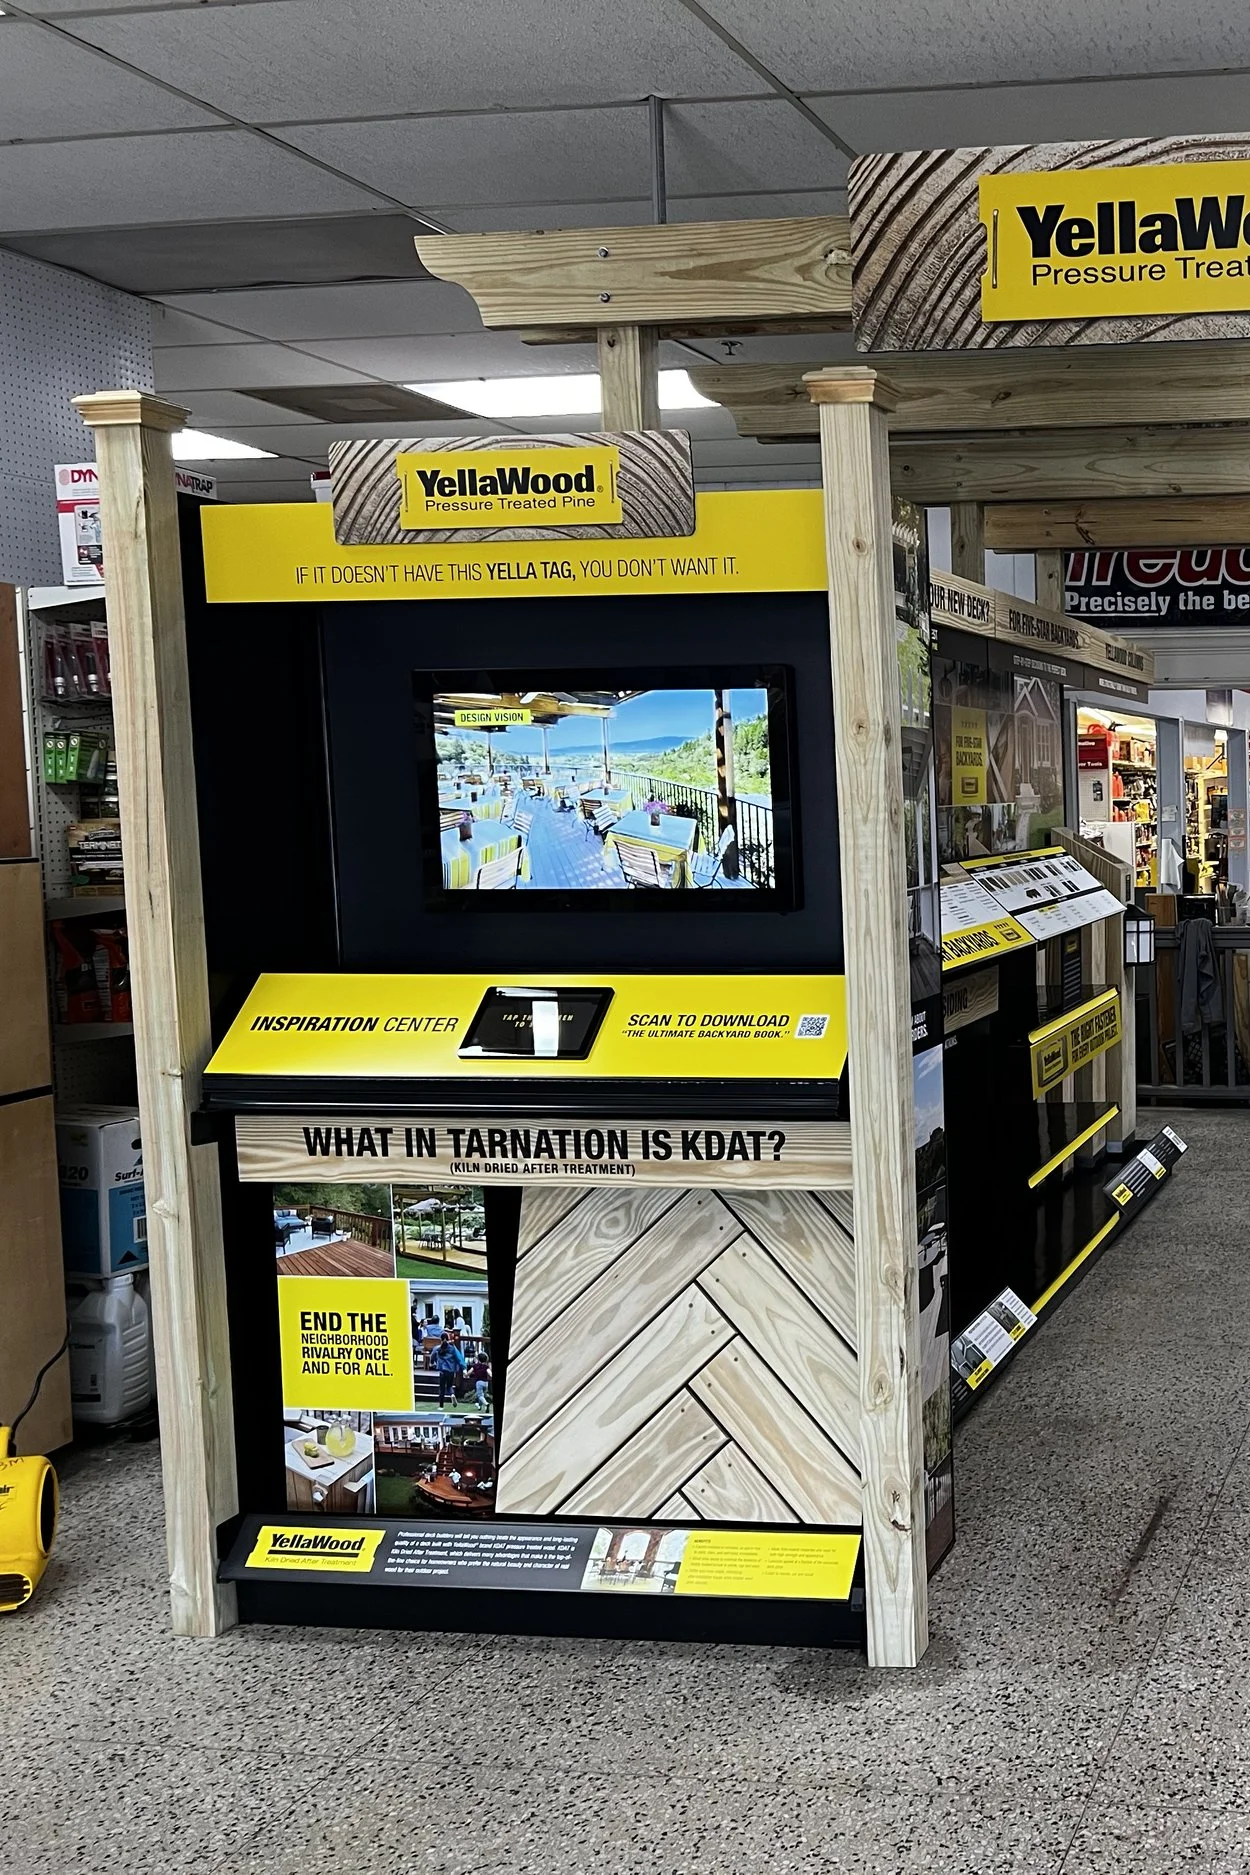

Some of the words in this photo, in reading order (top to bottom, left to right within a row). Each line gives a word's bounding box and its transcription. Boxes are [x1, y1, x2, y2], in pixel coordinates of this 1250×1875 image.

[1033, 264, 1166, 286] Pressure
[71, 469, 99, 484] DYN
[176, 472, 213, 493] NATRAP
[416, 465, 595, 497] YellaWood
[425, 500, 493, 512] Pressure
[497, 496, 556, 509] Treated
[562, 496, 595, 508] Pine
[296, 567, 308, 584] IF
[314, 566, 326, 584] IT
[331, 565, 399, 584] DOESN'T
[404, 564, 444, 582] HAVE
[447, 563, 482, 581] THIS
[486, 562, 537, 580] YELLA
[540, 561, 576, 581] TAG,
[580, 560, 612, 578] YOU
[617, 558, 667, 577] DON'T
[670, 557, 718, 576] WANT
[723, 557, 739, 575] IT.
[930, 583, 945, 608] OUR
[948, 590, 966, 615] NEW
[967, 595, 990, 623] DECK?
[1063, 591, 1171, 616] Precisely
[1179, 591, 1215, 610] the
[1008, 609, 1021, 632] FOR
[460, 713, 492, 722] DESIGN
[494, 713, 523, 722] VISION
[250, 1016, 380, 1031] INSPIRATION
[384, 1017, 459, 1032] CENTER
[628, 1014, 672, 1026] SCAN
[677, 1014, 697, 1027] TO
[700, 1015, 790, 1027] DOWNLOAD
[648, 1030, 695, 1038] ULTIMATE
[697, 1030, 751, 1038] BACKYARD
[302, 1126, 396, 1157] WHAT
[405, 1127, 437, 1158] IN
[446, 1128, 630, 1161] TARNATION
[641, 1129, 674, 1161] IS
[682, 1131, 787, 1162] KDAT?
[114, 1168, 144, 1181] Surf-
[450, 1162, 480, 1175] (KILN
[484, 1163, 518, 1173] DRIED
[522, 1163, 559, 1174] AFTER
[562, 1163, 636, 1177] TREATMENT)
[300, 1311, 342, 1331] END
[347, 1313, 387, 1333] THE
[301, 1333, 388, 1346] NEIGHBORHOOD
[302, 1346, 353, 1360] RIVALRY
[355, 1348, 389, 1361] ONCE
[302, 1361, 330, 1374] AND
[335, 1362, 360, 1375] FOR
[365, 1363, 393, 1376] ALL.
[271, 1533, 365, 1551] YellaWood
